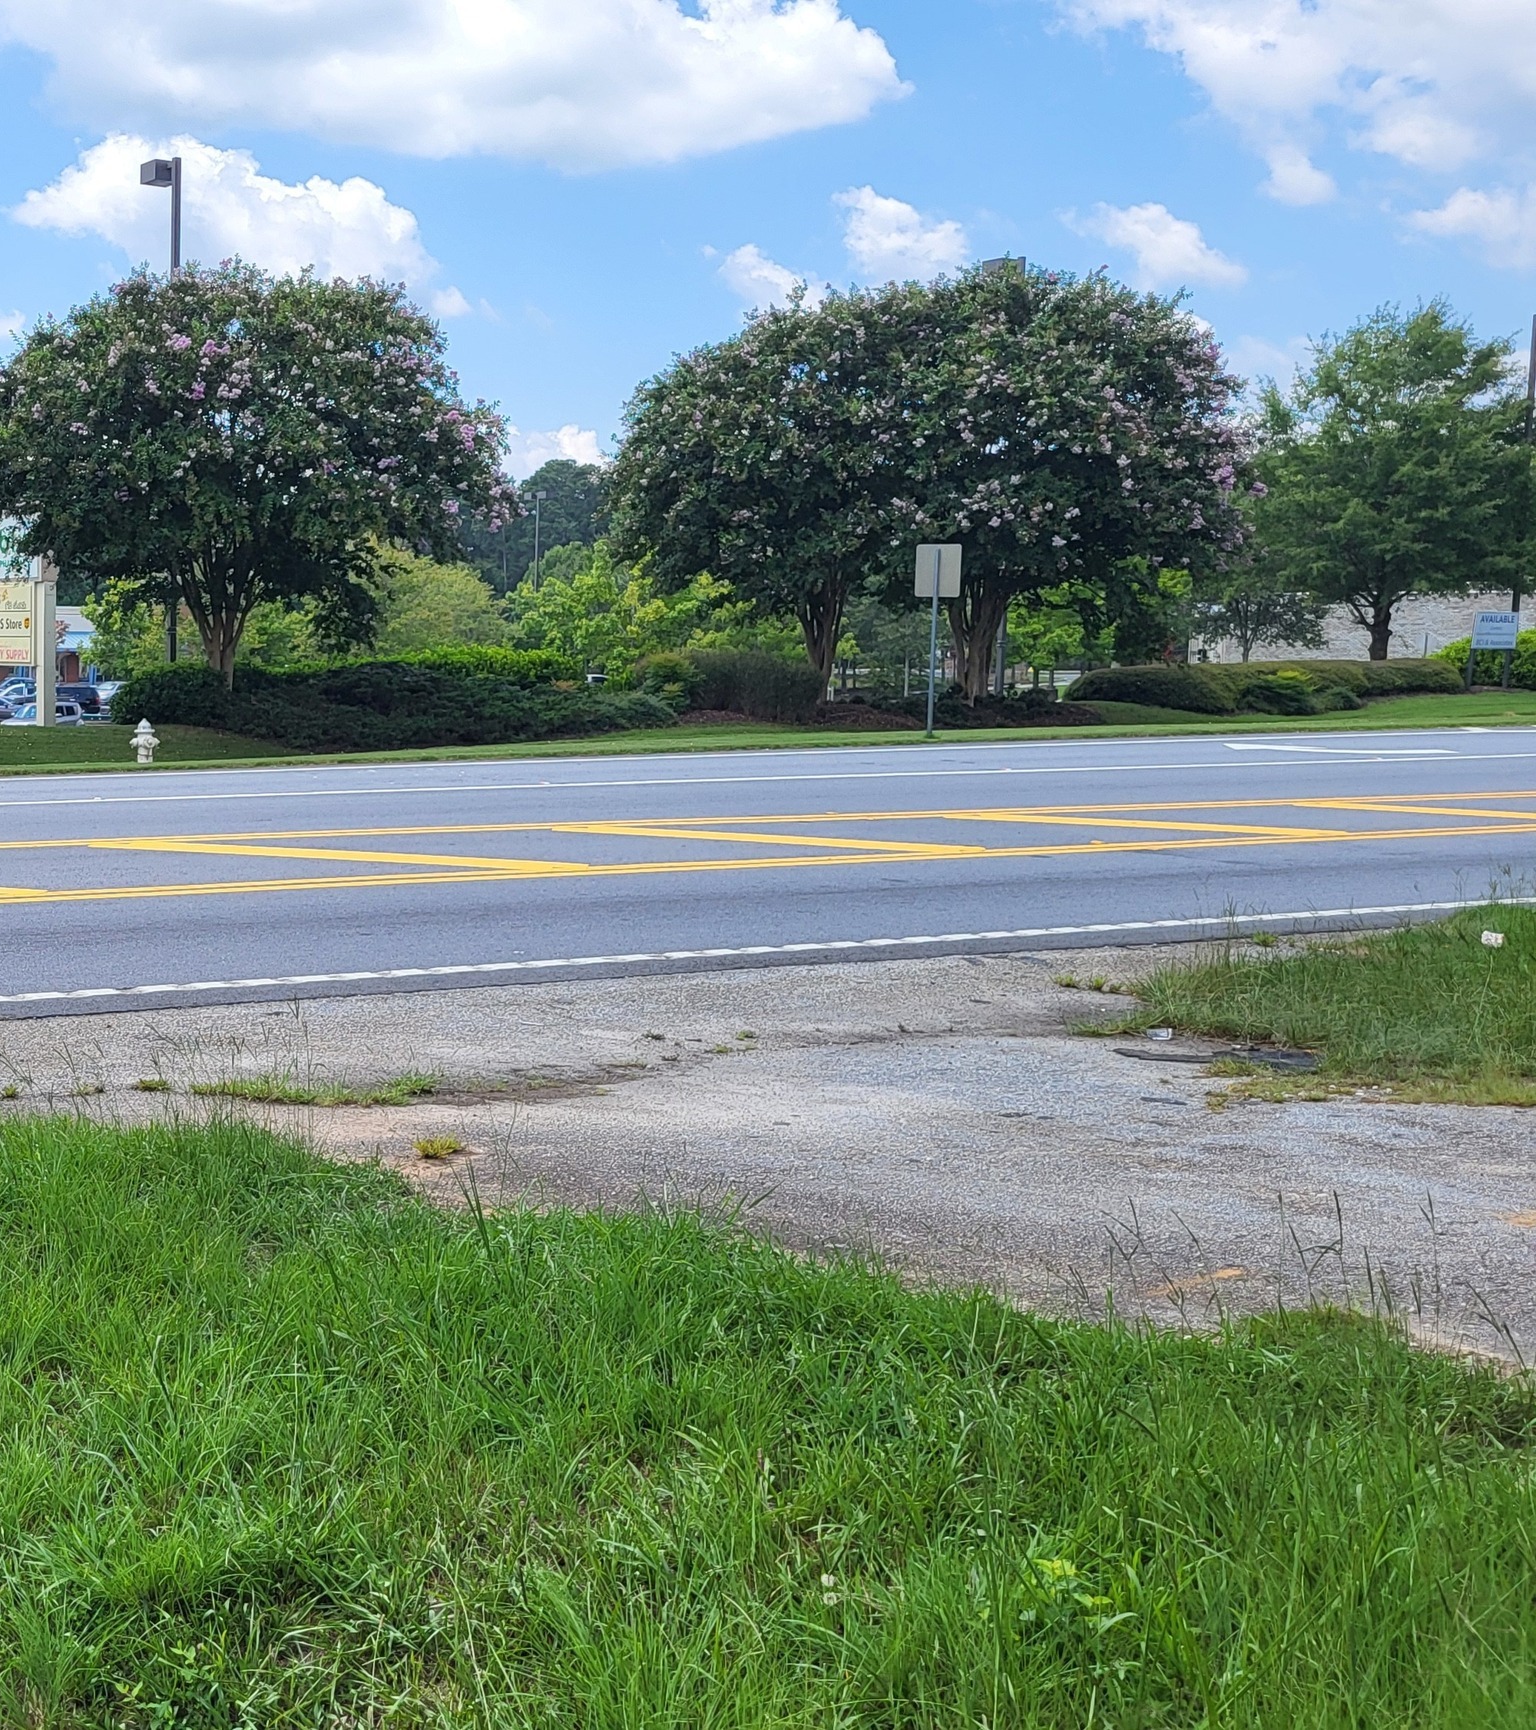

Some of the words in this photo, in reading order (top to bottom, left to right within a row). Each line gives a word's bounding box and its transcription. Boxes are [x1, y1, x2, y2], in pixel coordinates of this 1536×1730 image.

[5, 618, 23, 630] Store
[1480, 615, 1515, 623] AVAILABLE
[6, 649, 29, 660] SUPPLY
